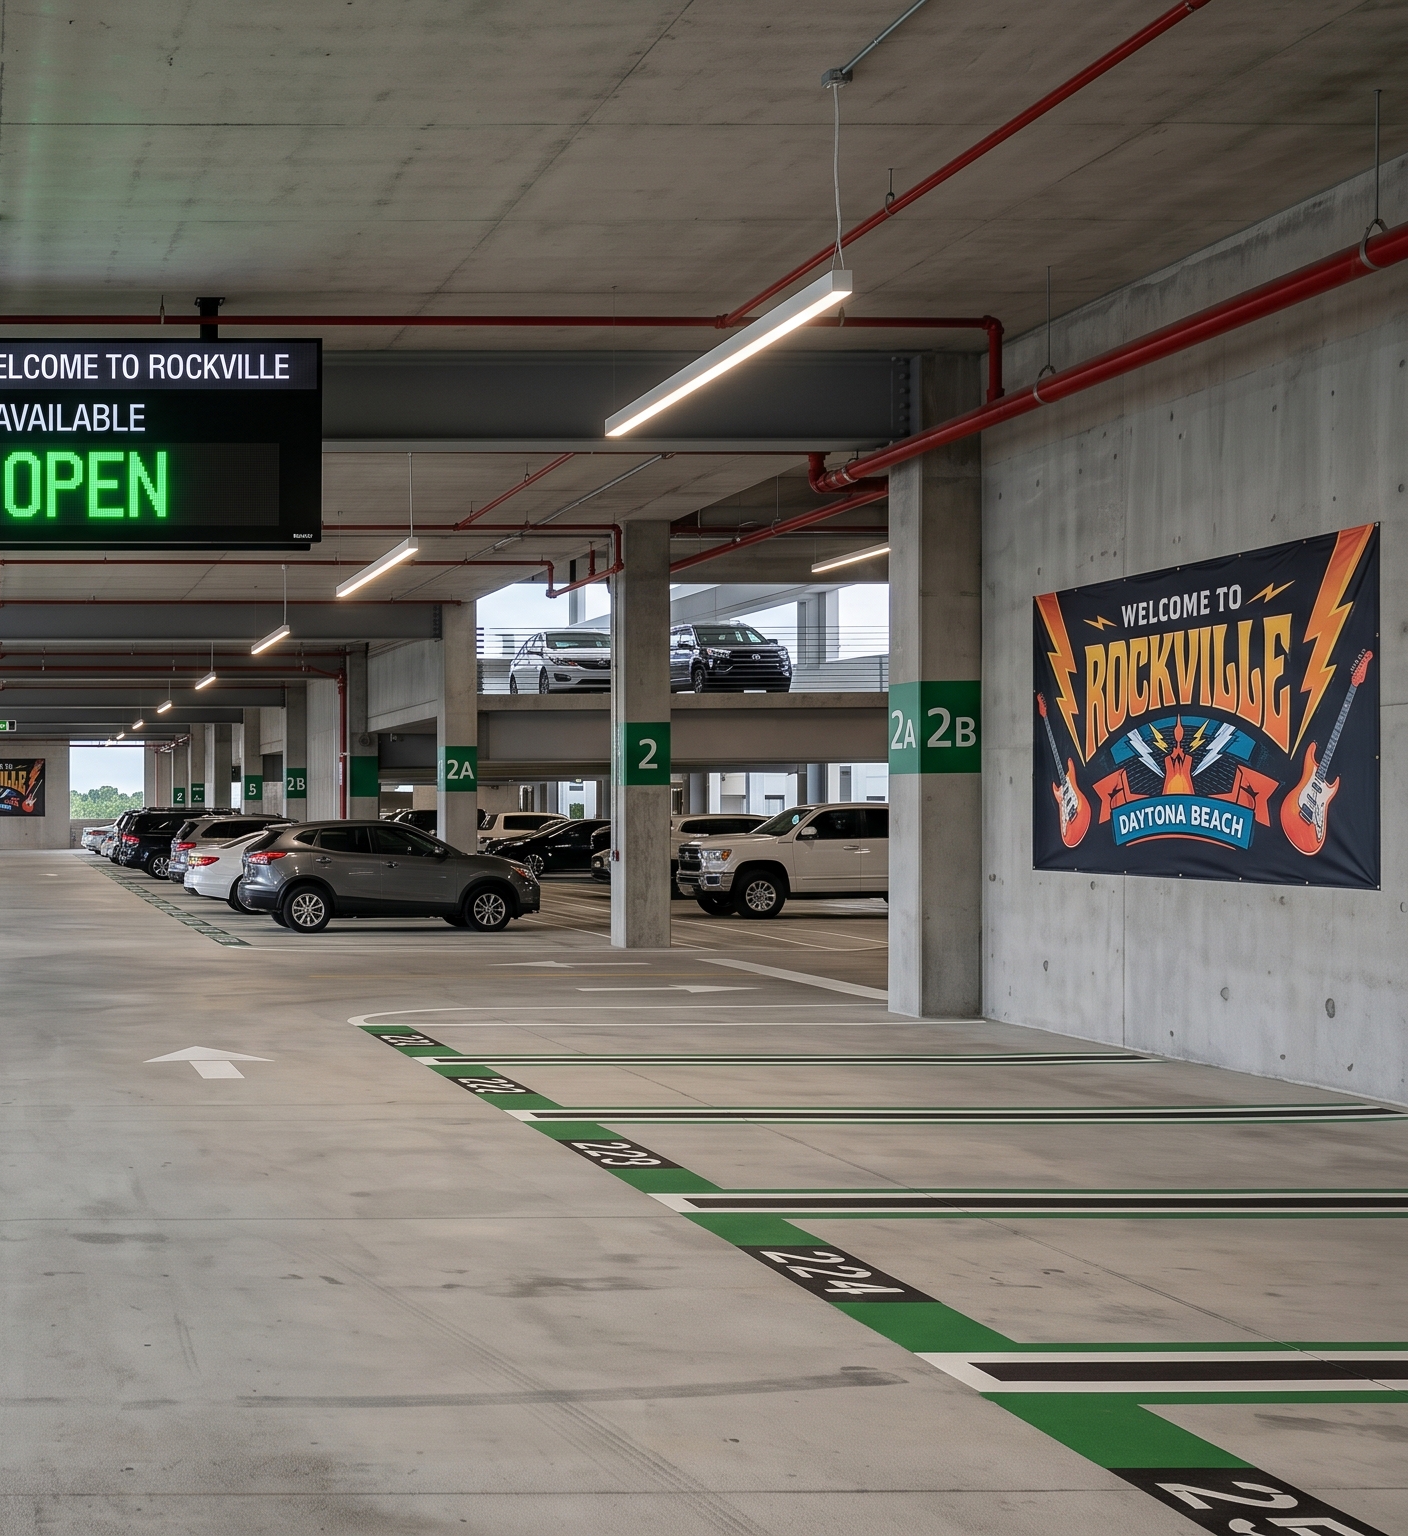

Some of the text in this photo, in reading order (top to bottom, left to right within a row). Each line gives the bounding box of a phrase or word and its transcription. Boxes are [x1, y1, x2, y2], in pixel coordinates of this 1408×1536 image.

[106, 353, 140, 380] TO
[148, 353, 290, 380] ROCKVILLE
[4, 451, 168, 518] OPEN
[1121, 584, 1242, 628] WELCOME TO
[1085, 613, 1292, 764] ROCKVILLE
[891, 709, 917, 750] 2A
[927, 707, 977, 748] 2B
[447, 759, 475, 780] 2A
[638, 738, 658, 769] 2
[248, 783, 257, 796] 5
[287, 777, 306, 791] 2B
[1119, 804, 1244, 838] DAYTONA BEACH
[759, 1250, 905, 1295] 224
